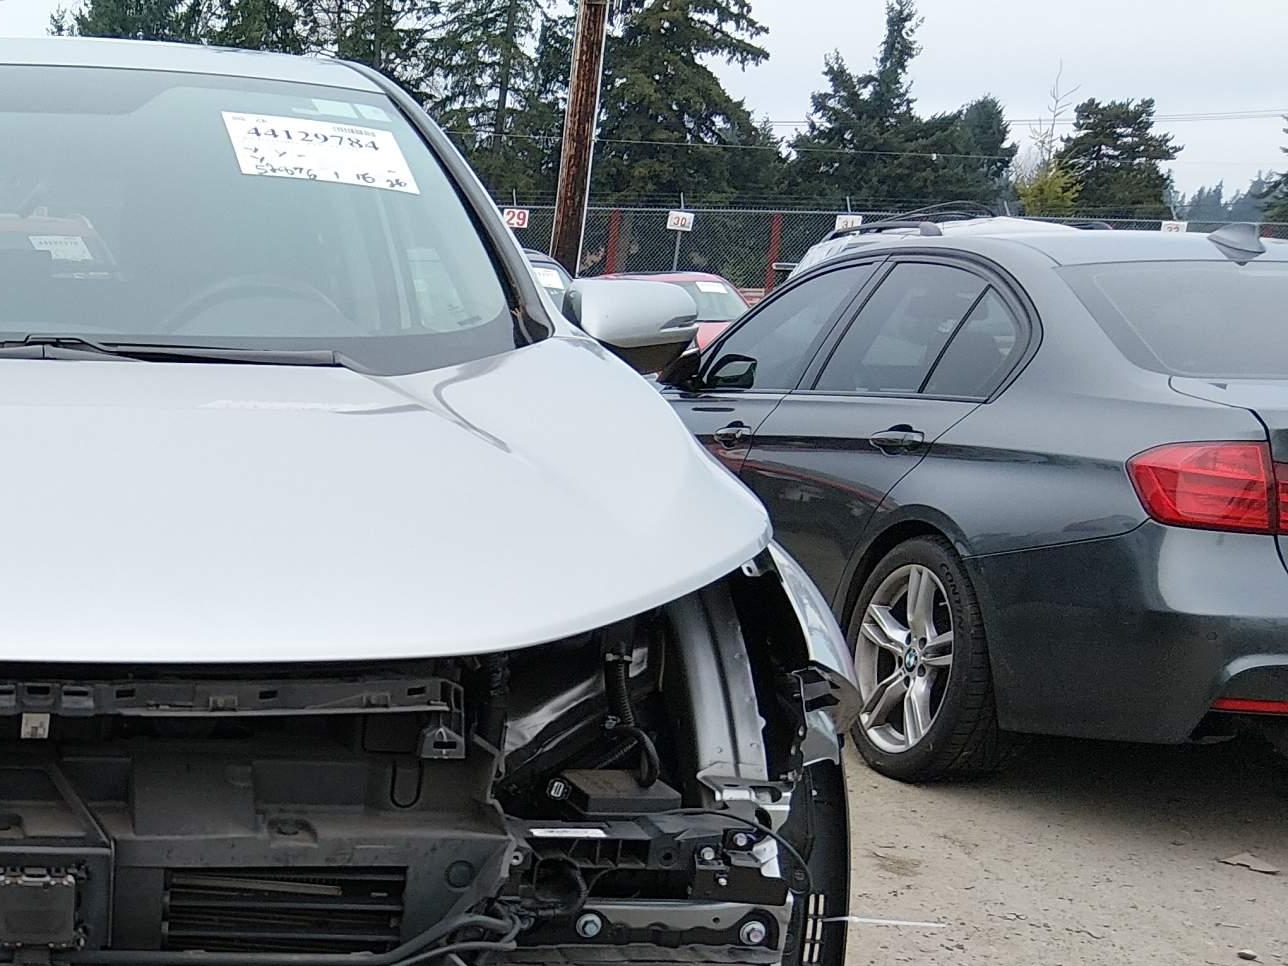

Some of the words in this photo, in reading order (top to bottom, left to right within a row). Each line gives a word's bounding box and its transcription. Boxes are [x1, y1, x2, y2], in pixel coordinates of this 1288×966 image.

[247, 126, 379, 151] 44129784
[506, 210, 527, 226] 29
[673, 216, 687, 227] 30
